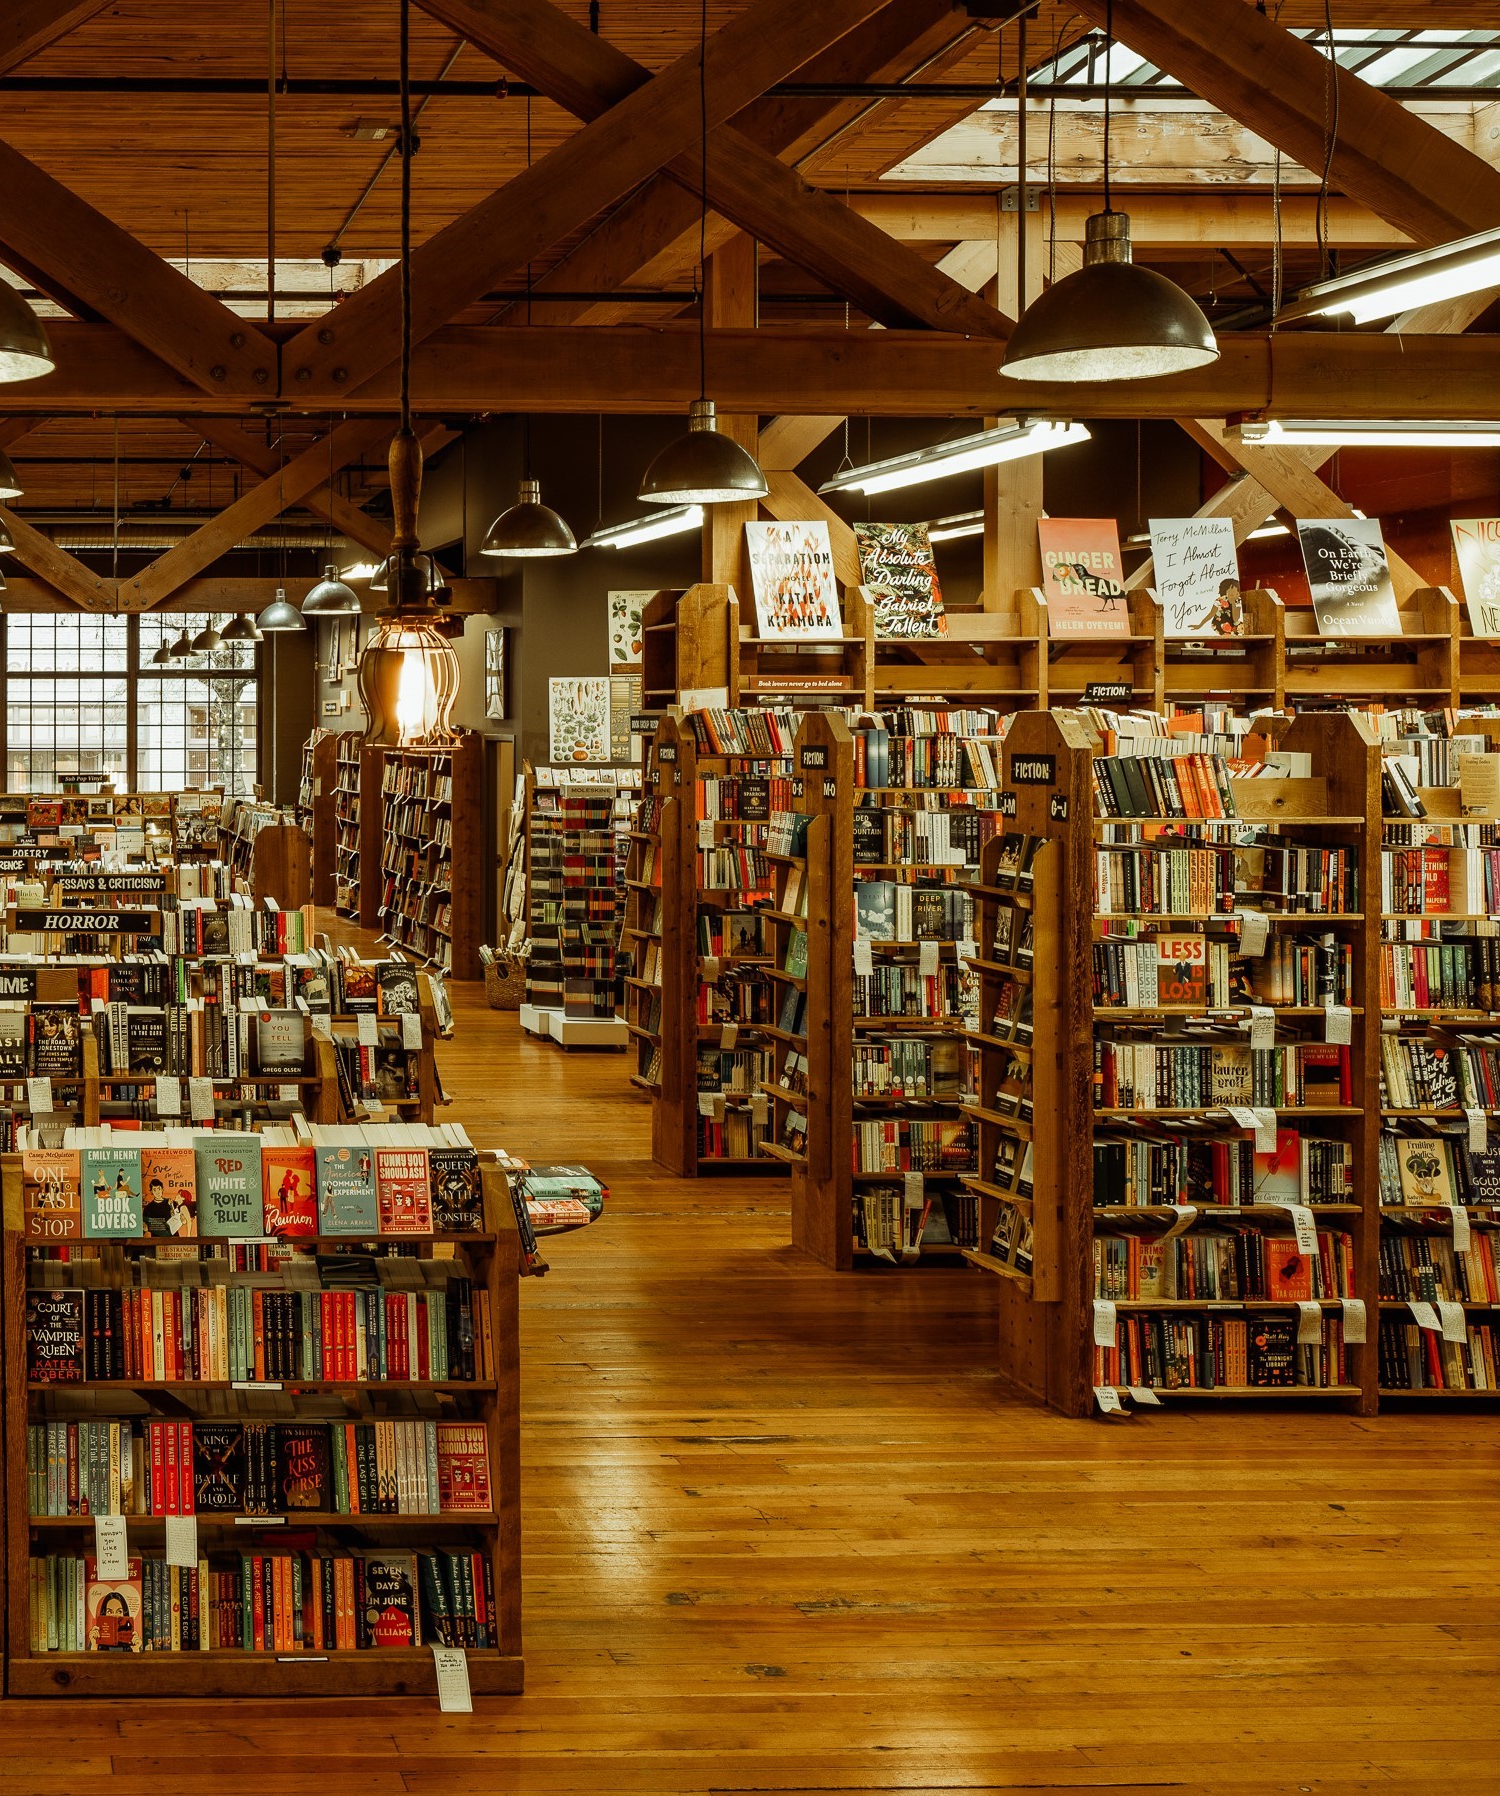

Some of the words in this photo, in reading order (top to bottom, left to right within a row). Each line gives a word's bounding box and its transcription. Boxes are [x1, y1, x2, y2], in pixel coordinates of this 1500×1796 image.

[881, 528, 909, 546] My
[1152, 530, 1179, 546] Terry
[1183, 524, 1231, 538] McMillan
[752, 552, 831, 566] SEPARATION
[864, 550, 934, 567] Absolute
[1045, 551, 1114, 569] GINGER
[1166, 552, 1177, 567] I
[1183, 545, 1222, 562] Almost
[1318, 548, 1336, 559] On
[1338, 548, 1372, 559] Earth
[1329, 558, 1364, 570] We're
[870, 567, 933, 590] Darling
[1160, 574, 1197, 598] Forgot
[1199, 560, 1237, 578] About
[1329, 570, 1368, 582] Briefly
[1325, 582, 1378, 594] Gorgeous
[779, 592, 815, 606] KATIE
[879, 596, 934, 614] Gabriel
[767, 614, 832, 628] KITAMURA
[1170, 602, 1208, 629] You
[1323, 614, 1358, 626] Ocean
[1359, 615, 1395, 627] Vuong
[884, 613, 939, 633] Tallent
[1056, 621, 1084, 630] HELEN
[1086, 621, 1125, 630] OYEYEMI
[1092, 686, 1127, 697] FICTION
[660, 748, 675, 760] FICTION
[803, 752, 824, 766] FICTION
[1014, 762, 1050, 779] FICTION
[793, 782, 803, 796] O-R
[823, 783, 836, 796] M-O
[1002, 799, 1016, 815] J-M
[1051, 800, 1068, 818] G-J
[12, 850, 49, 858] POETRY
[59, 878, 95, 890] ESSAYS
[98, 878, 107, 889] &
[109, 878, 160, 889] CRITICISM
[44, 915, 120, 930] HORROR
[1161, 941, 1202, 959] LESS
[1161, 982, 1203, 998] LOST
[88, 1151, 112, 1160] EMILY
[113, 1151, 138, 1160] HENRY
[380, 1153, 406, 1167] FUNNY
[407, 1153, 424, 1166] YOU
[214, 1159, 243, 1174] RED
[380, 1168, 406, 1179] SHOULD
[408, 1168, 425, 1179] ASK
[34, 1167, 69, 1183] ONE
[169, 1180, 193, 1188] Brain
[208, 1177, 246, 1191] WHITE
[248, 1178, 257, 1189] &
[31, 1192, 76, 1209] LAST
[97, 1198, 130, 1213] BOOK
[210, 1192, 252, 1206] ROYAL
[91, 1214, 137, 1229] LOVERS
[214, 1209, 248, 1224] BLUE
[266, 1212, 313, 1234] Reunion
[433, 1212, 481, 1222] MONSTERS
[31, 1218, 74, 1236] STOP
[1275, 1290, 1287, 1298] YAA
[1288, 1289, 1307, 1297] GYASI
[37, 1302, 74, 1313] COURT
[31, 1329, 79, 1342] VAMPIRE
[37, 1345, 75, 1357] QUEEN
[35, 1360, 75, 1368] KATEE
[30, 1370, 82, 1379] ROBERT
[203, 1435, 229, 1445] KING
[284, 1439, 313, 1452] THE
[289, 1459, 316, 1475] KISS
[372, 1567, 402, 1575] SEVEN
[376, 1582, 400, 1590] DAYS
[367, 1628, 412, 1637] WILLIAMS
